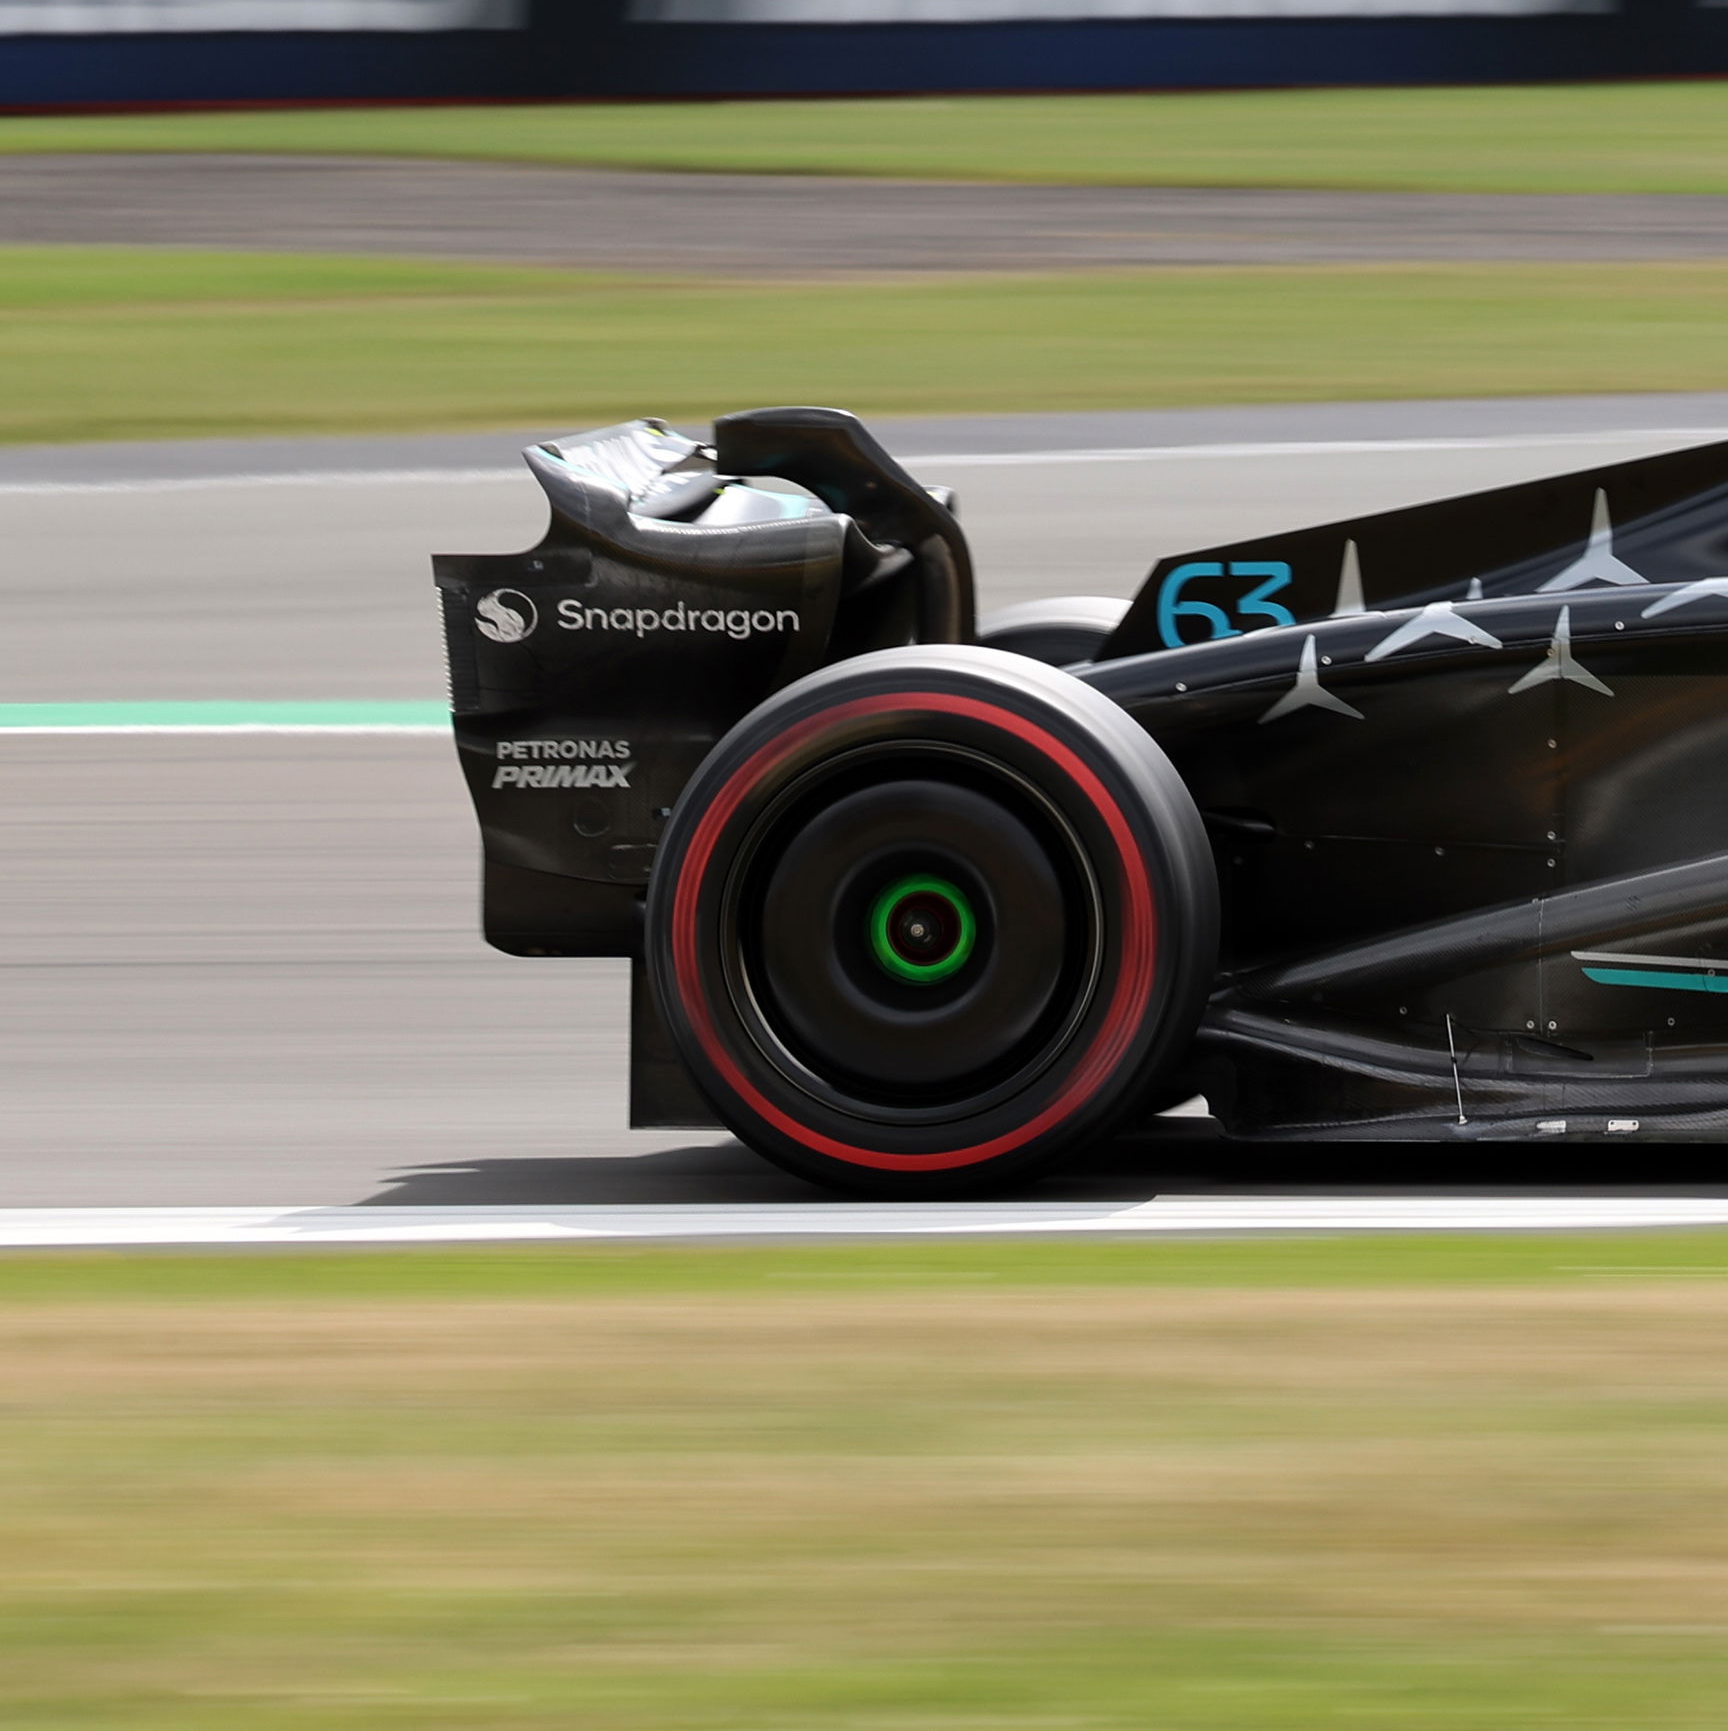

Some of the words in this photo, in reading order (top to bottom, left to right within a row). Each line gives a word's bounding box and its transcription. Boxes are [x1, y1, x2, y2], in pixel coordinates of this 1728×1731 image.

[556, 598, 801, 640] Snapdragon
[1157, 560, 1297, 649] 63
[496, 739, 632, 760] PETRONAS
[491, 762, 637, 790] PRIMAX
